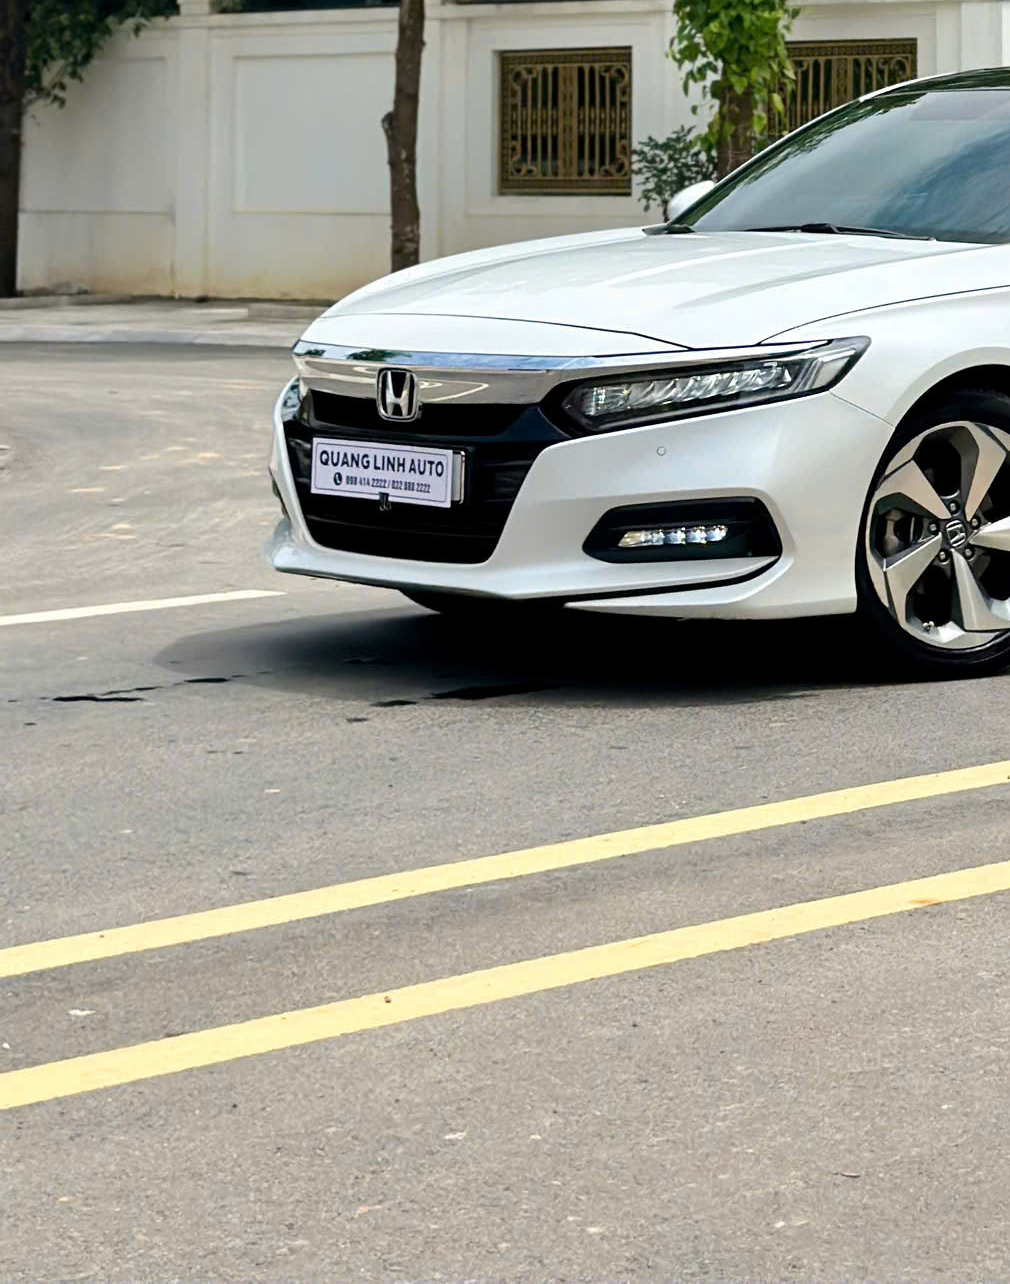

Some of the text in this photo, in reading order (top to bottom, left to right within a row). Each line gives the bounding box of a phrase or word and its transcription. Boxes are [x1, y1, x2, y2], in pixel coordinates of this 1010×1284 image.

[319, 450, 445, 477] QUANG LINH AUTO
